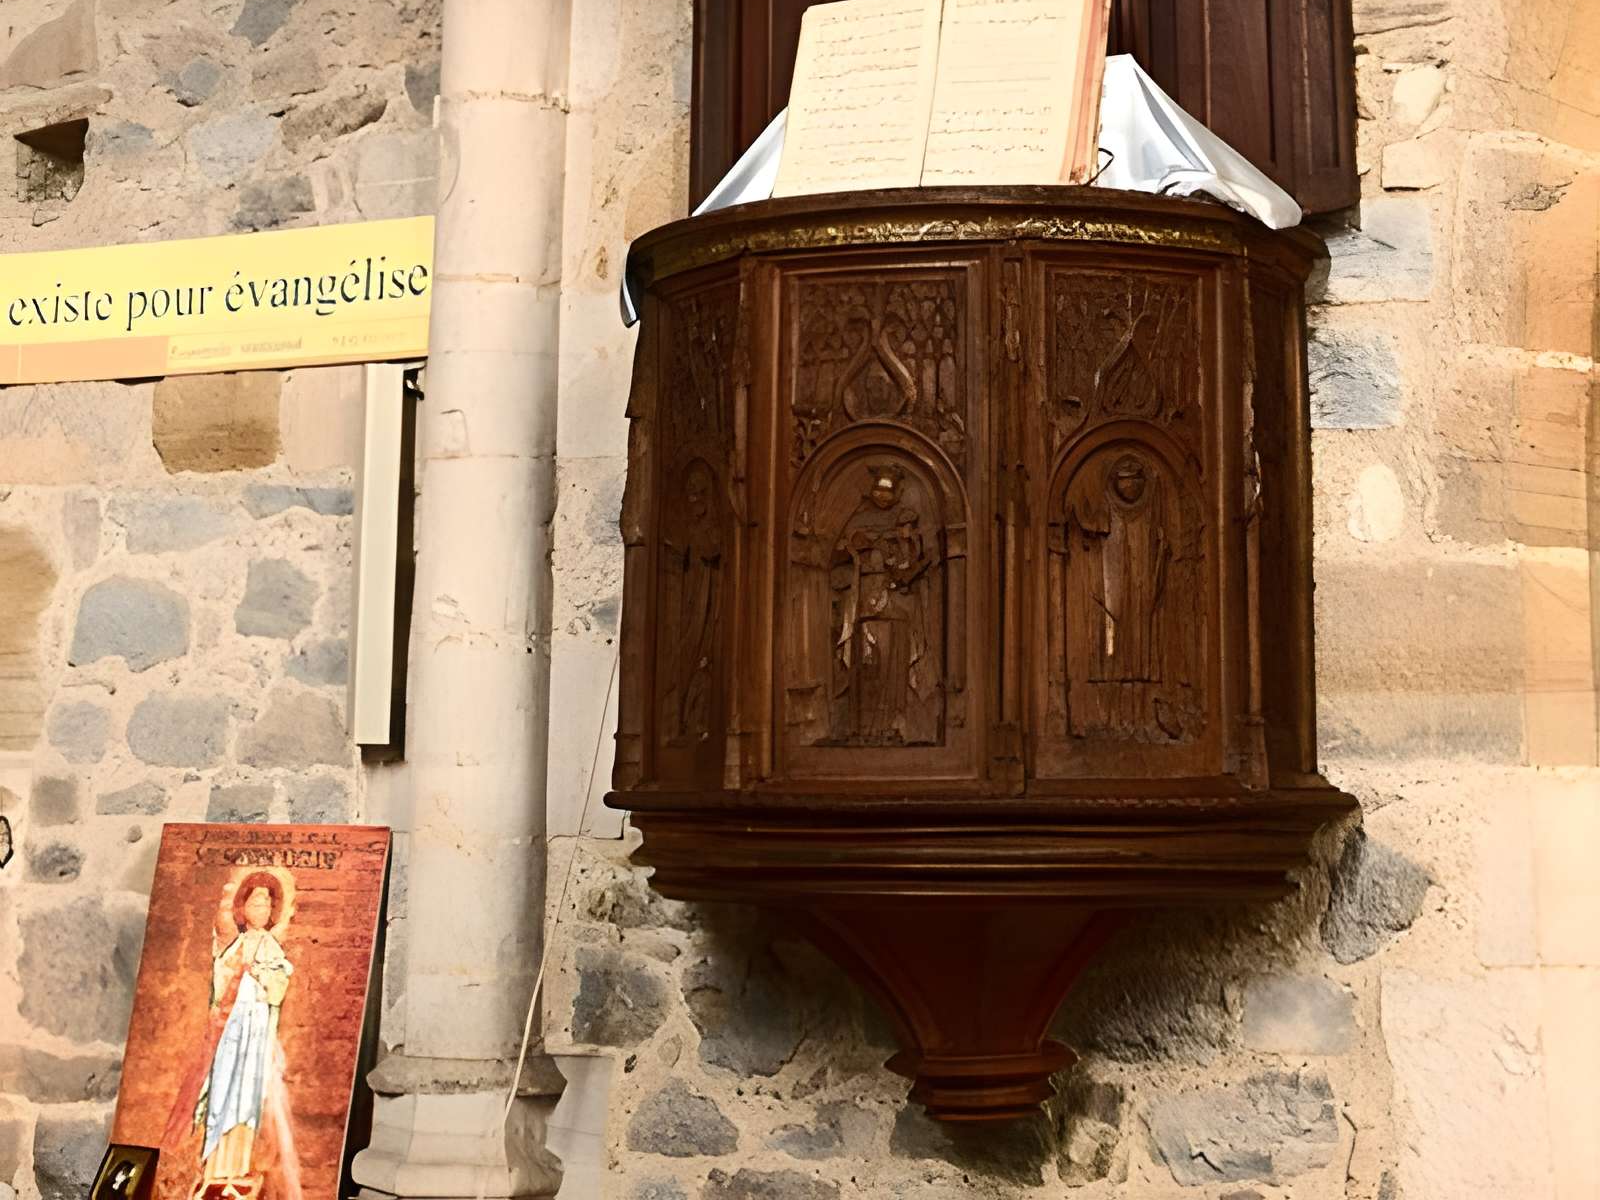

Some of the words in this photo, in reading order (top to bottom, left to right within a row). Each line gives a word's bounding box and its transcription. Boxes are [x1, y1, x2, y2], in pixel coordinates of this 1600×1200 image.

[9, 283, 113, 326] existe
[127, 285, 213, 331] pour
[225, 256, 428, 316] évangélise
